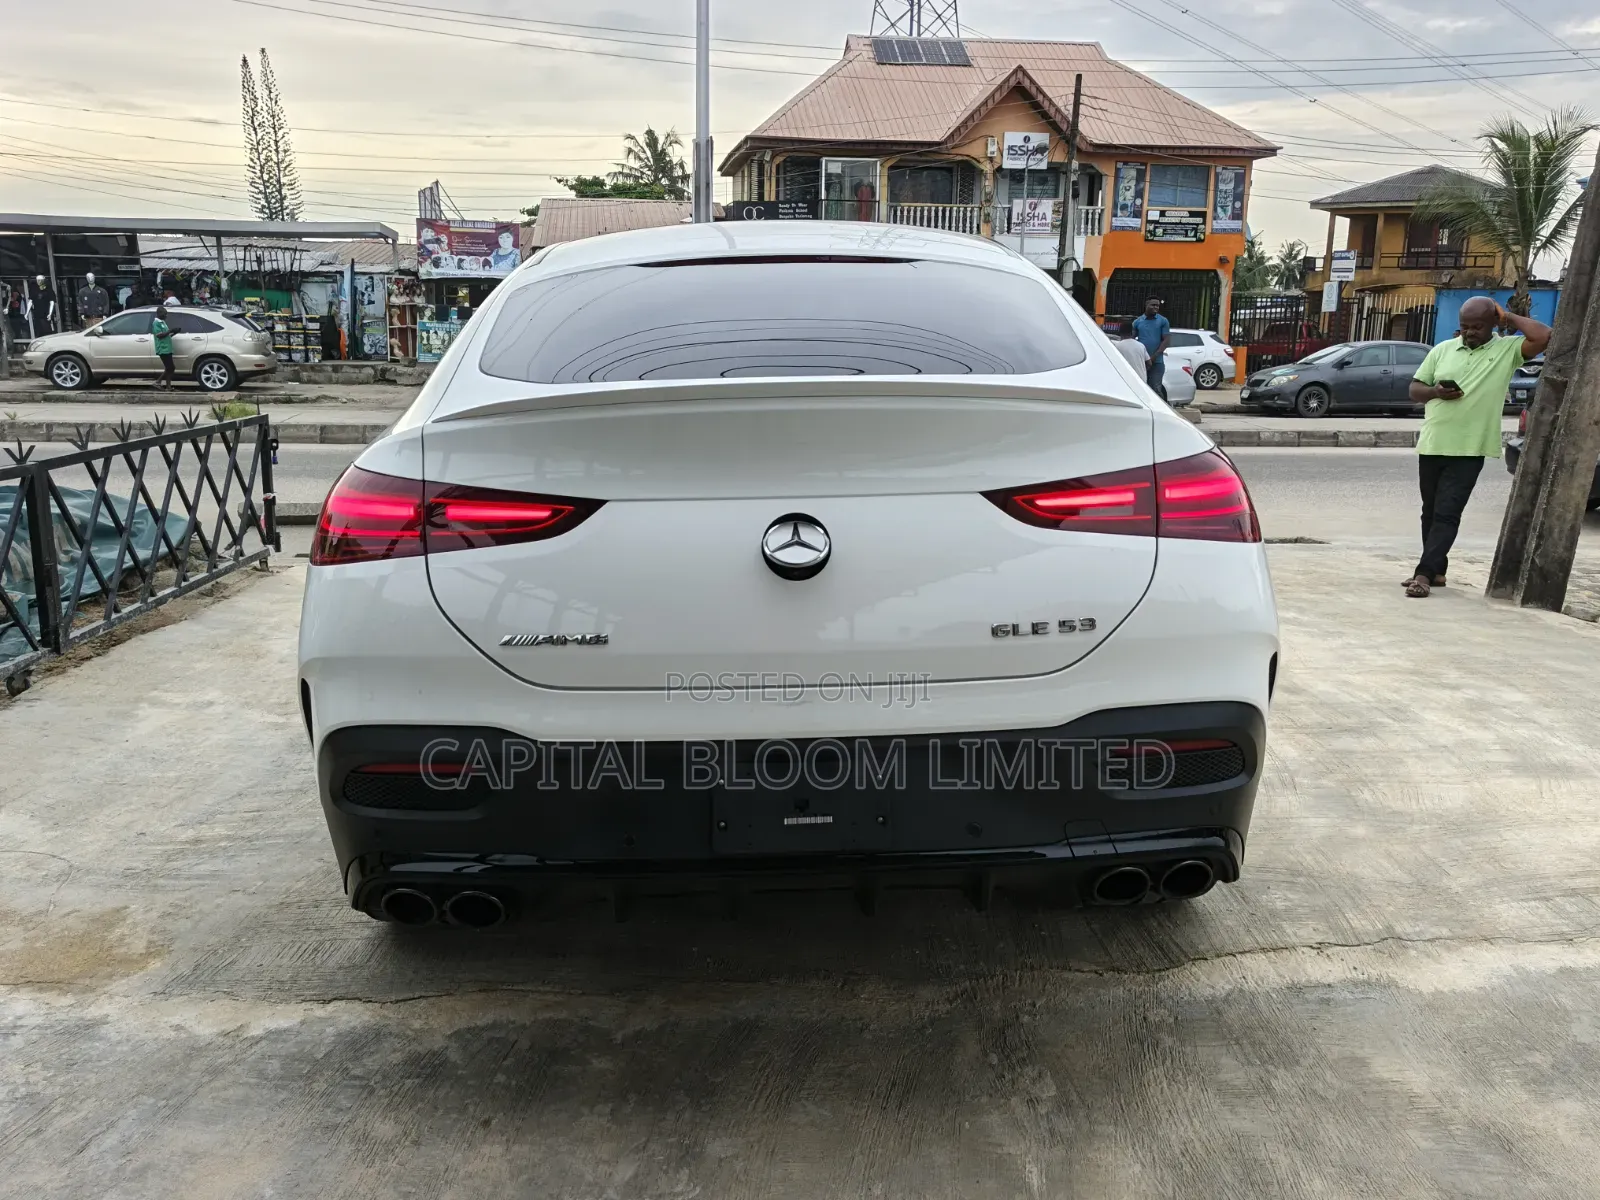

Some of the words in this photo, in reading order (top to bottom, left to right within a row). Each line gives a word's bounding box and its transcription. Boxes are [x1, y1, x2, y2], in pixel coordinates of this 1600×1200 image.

[1006, 144, 1045, 157] ISSH
[991, 620, 1050, 638] GLE
[1058, 616, 1097, 634] 53
[535, 634, 608, 646] AMG
